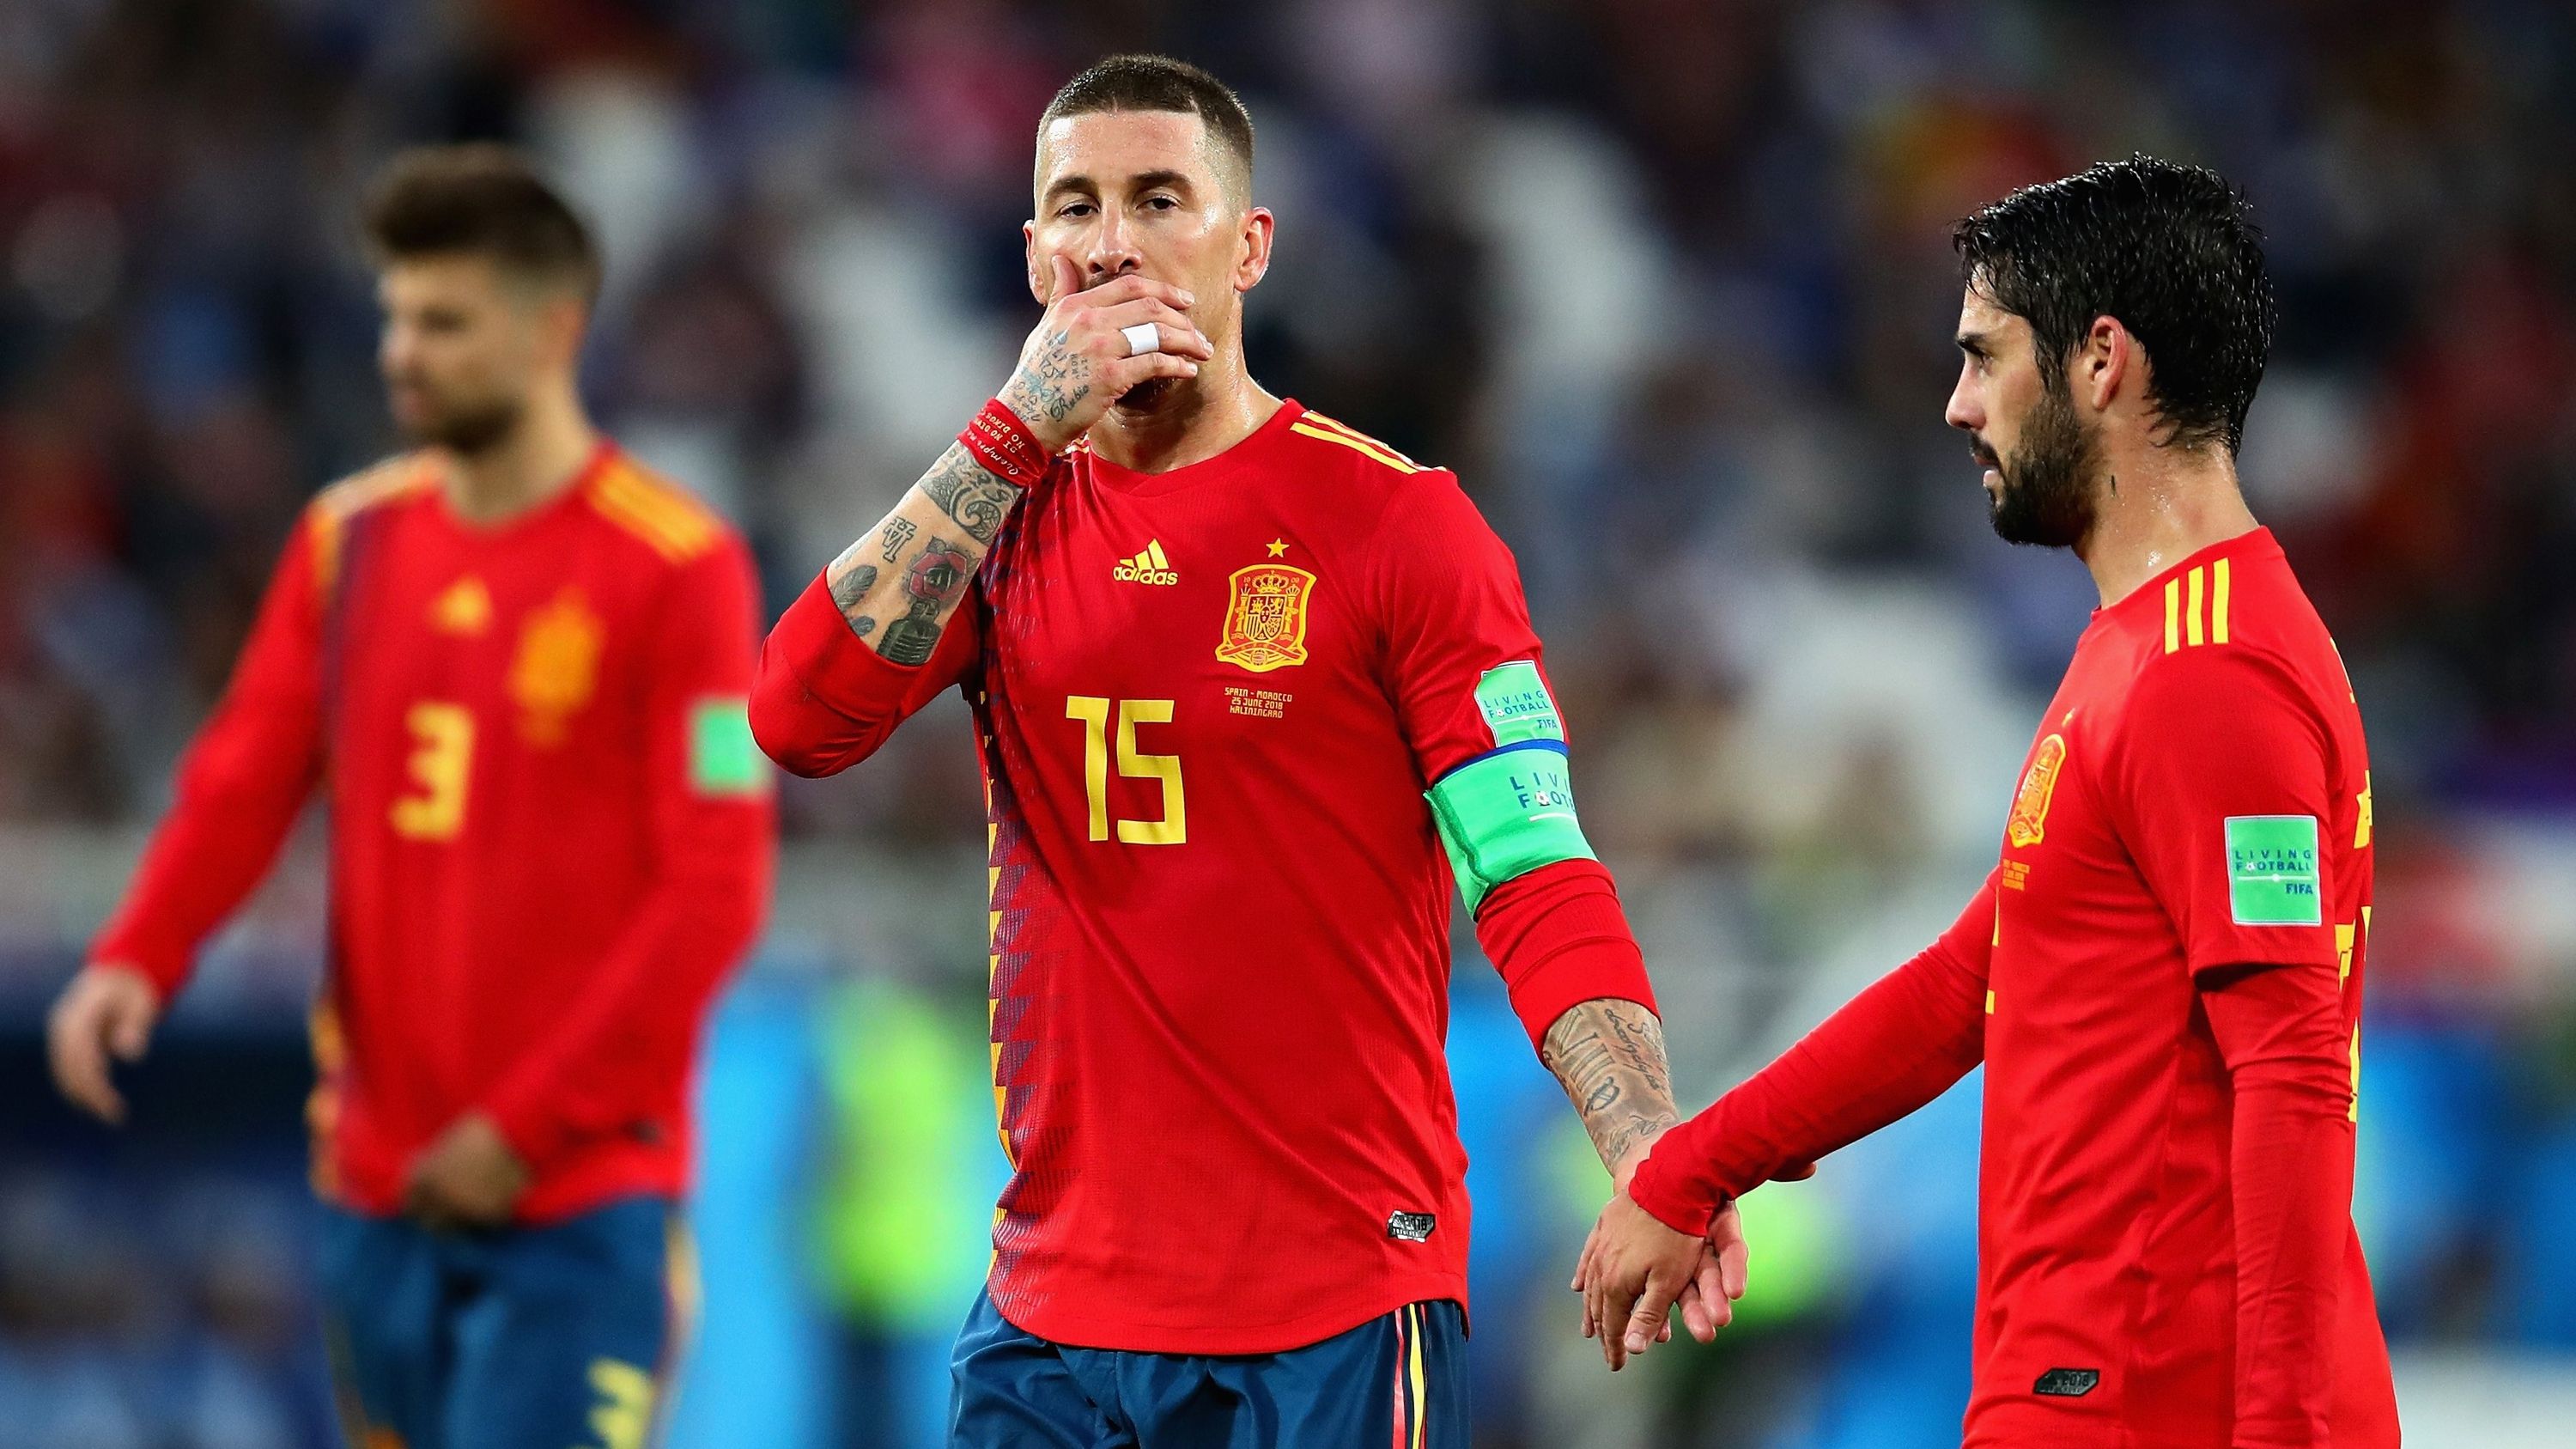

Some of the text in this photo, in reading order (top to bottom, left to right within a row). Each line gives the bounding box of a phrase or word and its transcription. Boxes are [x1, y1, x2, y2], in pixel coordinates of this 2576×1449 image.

[1011, 434, 1026, 449] NO
[1114, 566, 1179, 586] adidas
[1224, 687, 1249, 697] SPAIN
[1256, 691, 1293, 703] MOROCCO
[1484, 691, 1544, 709] LIVING
[1231, 697, 1283, 710] 25 JUNE 2018
[1488, 701, 1549, 719] FOOTBALL
[1230, 705, 1284, 718] KALININGRAD
[1537, 719, 1558, 730] FIFA
[388, 702, 473, 843] 3
[1066, 696, 1187, 844] 15
[2235, 849, 2312, 860] LIVING
[2235, 861, 2310, 872] FOOTBALL
[2286, 883, 2313, 894] FIFA
[570, 1356, 654, 1449] 3
